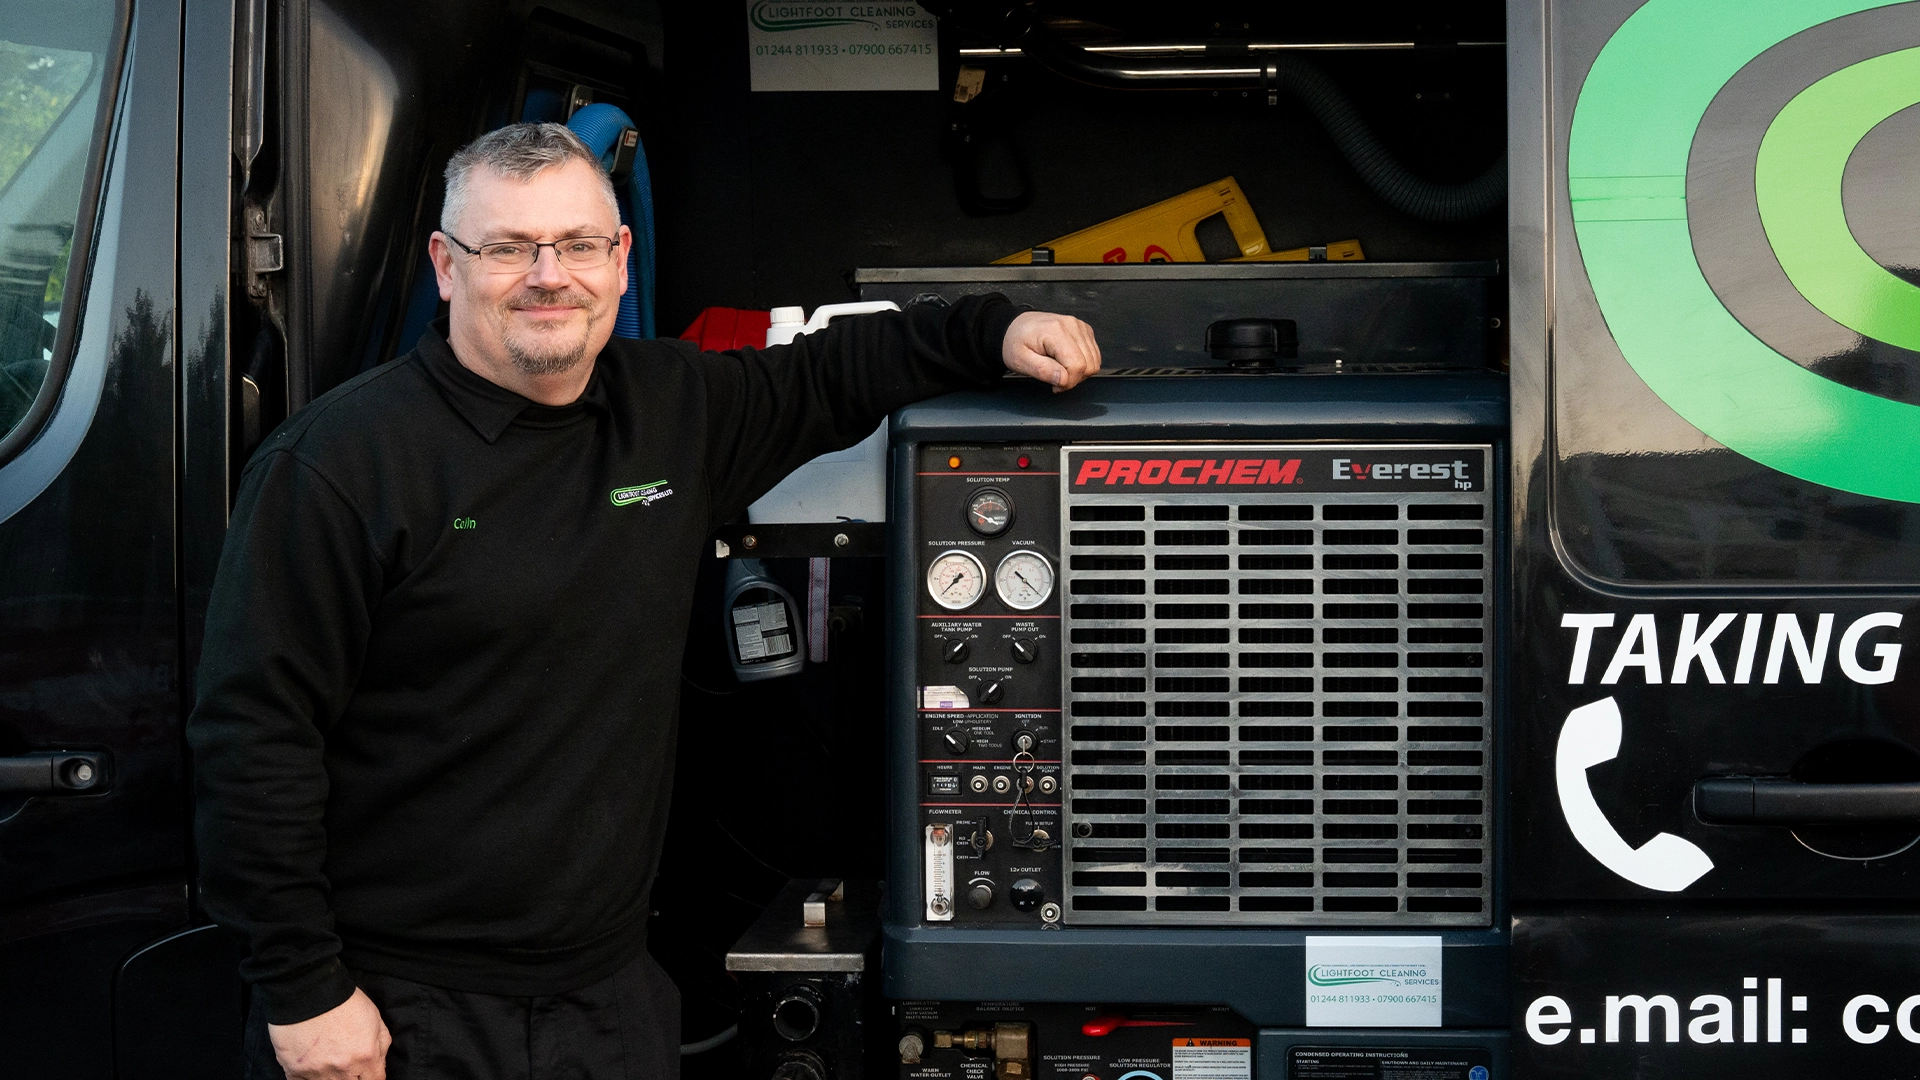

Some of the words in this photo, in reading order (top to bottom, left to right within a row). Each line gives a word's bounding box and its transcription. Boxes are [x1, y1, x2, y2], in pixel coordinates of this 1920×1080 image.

[768, 6, 843, 18] LIGHTFOOT
[850, 6, 916, 17] CLEANING
[885, 19, 934, 29] SERVICES
[756, 45, 792, 56] 01244
[795, 45, 839, 56] 811933
[850, 44, 886, 55] 07900
[888, 44, 932, 55] 667415
[1075, 459, 1301, 485] PROCHEM
[1332, 458, 1469, 480] Everest
[1454, 480, 1472, 490] hp
[1560, 612, 1903, 685] TAKING
[1321, 969, 1375, 977] LIGHTFOOT
[1379, 969, 1427, 977] CLEANING
[1310, 995, 1336, 1003] 01244
[1338, 995, 1370, 1003] 811933
[1377, 995, 1404, 1003] 07900
[1405, 995, 1437, 1003] 667415
[1525, 977, 1808, 1045] e.mail:
